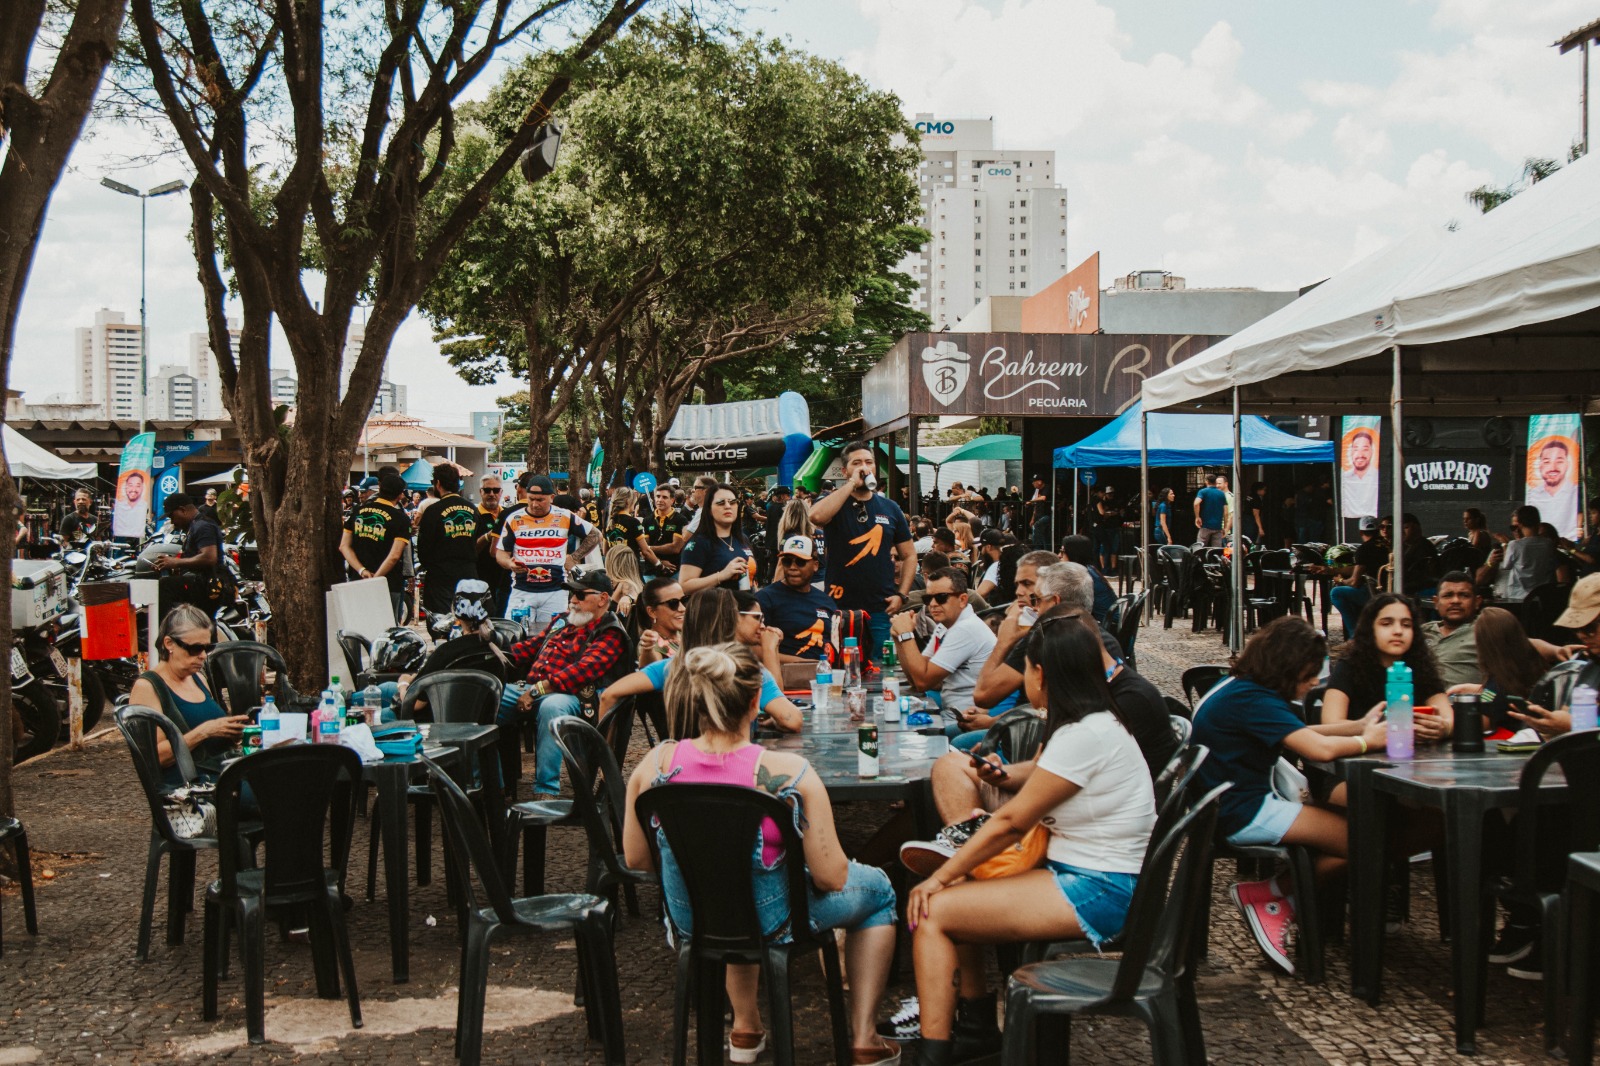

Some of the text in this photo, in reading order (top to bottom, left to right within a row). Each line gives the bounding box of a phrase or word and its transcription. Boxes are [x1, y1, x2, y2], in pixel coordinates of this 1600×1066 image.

[915, 122, 955, 134] CMO
[988, 168, 1012, 176] CMO
[979, 347, 1088, 400] Bahrem
[1029, 397, 1088, 408] PECUÁRIA
[691, 447, 748, 461] MOTOS
[1405, 460, 1492, 489] CUMPAD'S
[520, 529, 560, 537] REPSOL
[517, 549, 562, 558] HONDA
[828, 584, 844, 599] 70
